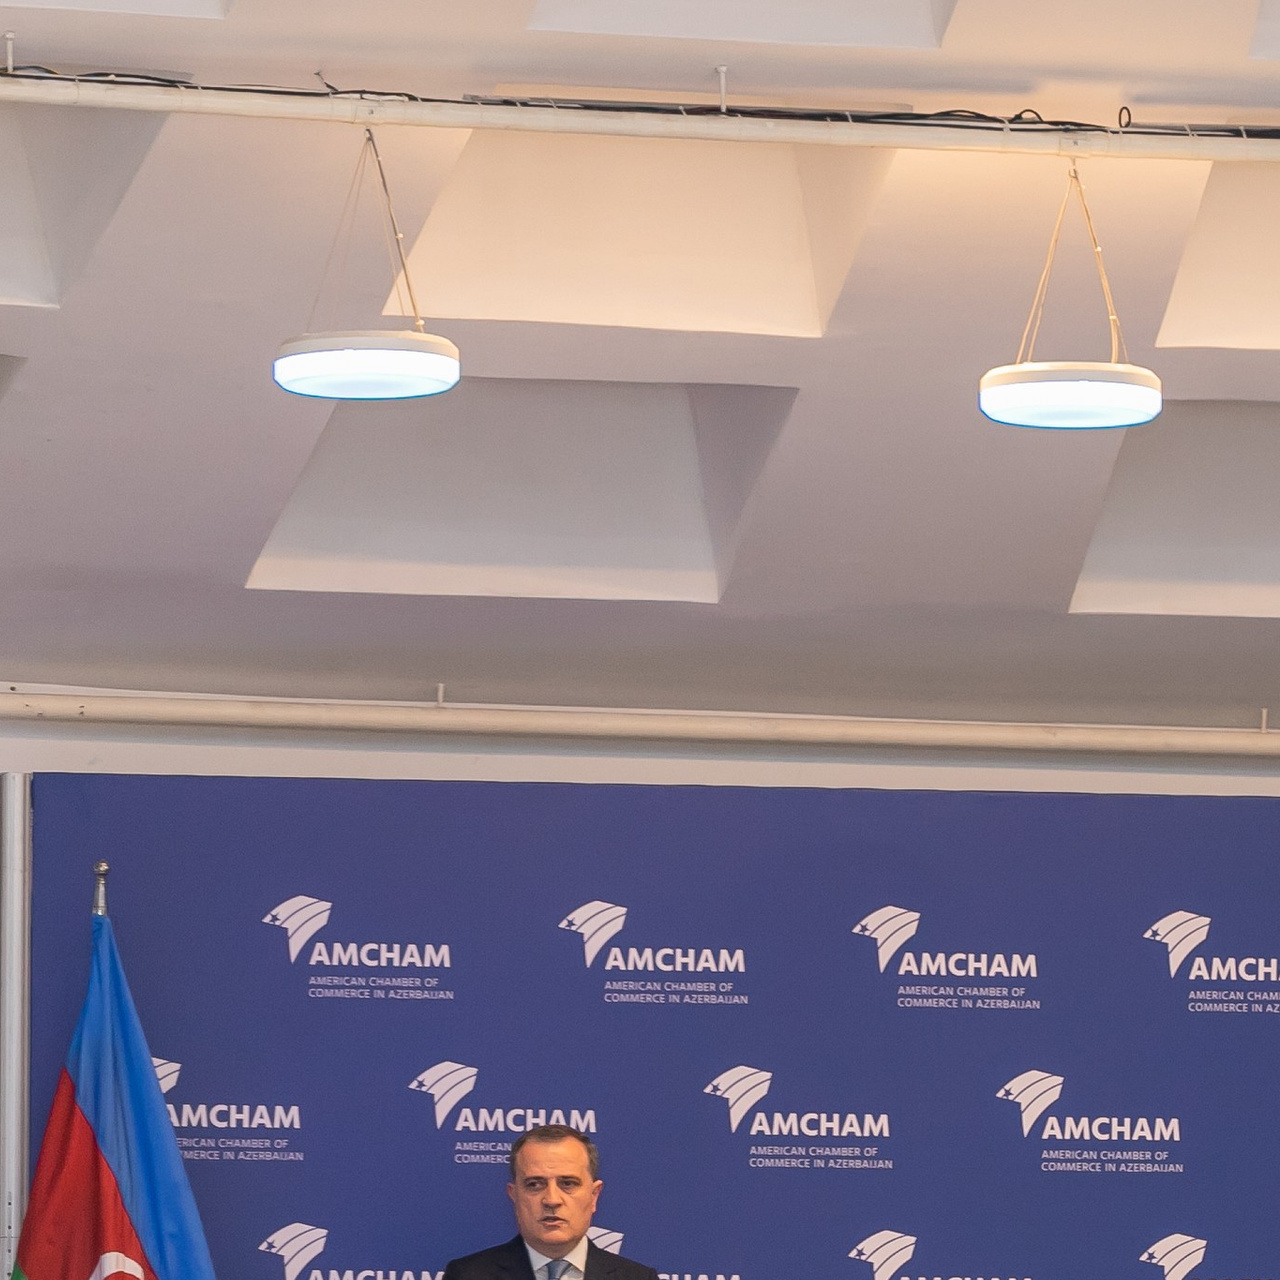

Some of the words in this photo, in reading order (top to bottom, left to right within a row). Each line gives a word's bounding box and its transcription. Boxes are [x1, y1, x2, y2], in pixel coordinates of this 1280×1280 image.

[308, 943, 451, 967] AMCHAM
[604, 948, 746, 972] AMCHAM
[897, 953, 1038, 977] AMCHAM
[308, 976, 367, 986] AMERICAN
[368, 976, 422, 987] CHAMBER
[423, 977, 439, 988] OF
[603, 980, 662, 991] AMERICAN
[663, 981, 717, 992] CHAMBER
[718, 982, 734, 992] OF
[308, 988, 371, 999] COMMERCE
[373, 989, 386, 999] IN
[897, 985, 954, 996] AMERICAN
[956, 986, 1009, 997] CHAMBER
[1011, 987, 1026, 997] OF
[1188, 990, 1245, 1001] AMERICAN
[603, 992, 666, 1004] COMMERCE
[668, 994, 681, 1004] IN
[896, 997, 959, 1009] COMMERCE
[961, 998, 973, 1009] IN
[1187, 1002, 1249, 1013] COMMERCE
[1251, 1003, 1263, 1013] IN
[749, 1113, 890, 1136] AMCHAM
[1041, 1117, 1181, 1140] AMCHAM
[175, 1137, 216, 1149] ERICAN
[217, 1138, 271, 1149] CHAMBER
[273, 1139, 290, 1149] OF
[222, 1150, 235, 1161] IN
[749, 1145, 806, 1156] AMERICAN
[808, 1146, 862, 1157] CHAMBER
[863, 1147, 879, 1157] OF
[1040, 1149, 1098, 1160] AMERICAN
[1099, 1150, 1152, 1161] CHAMBER
[1154, 1151, 1169, 1161] OF
[454, 1153, 511, 1164] COMMERC
[748, 1157, 811, 1168] COMMERCE
[813, 1158, 825, 1168] IN
[1040, 1161, 1102, 1172] COMMERCE
[1104, 1162, 1117, 1172] IN
